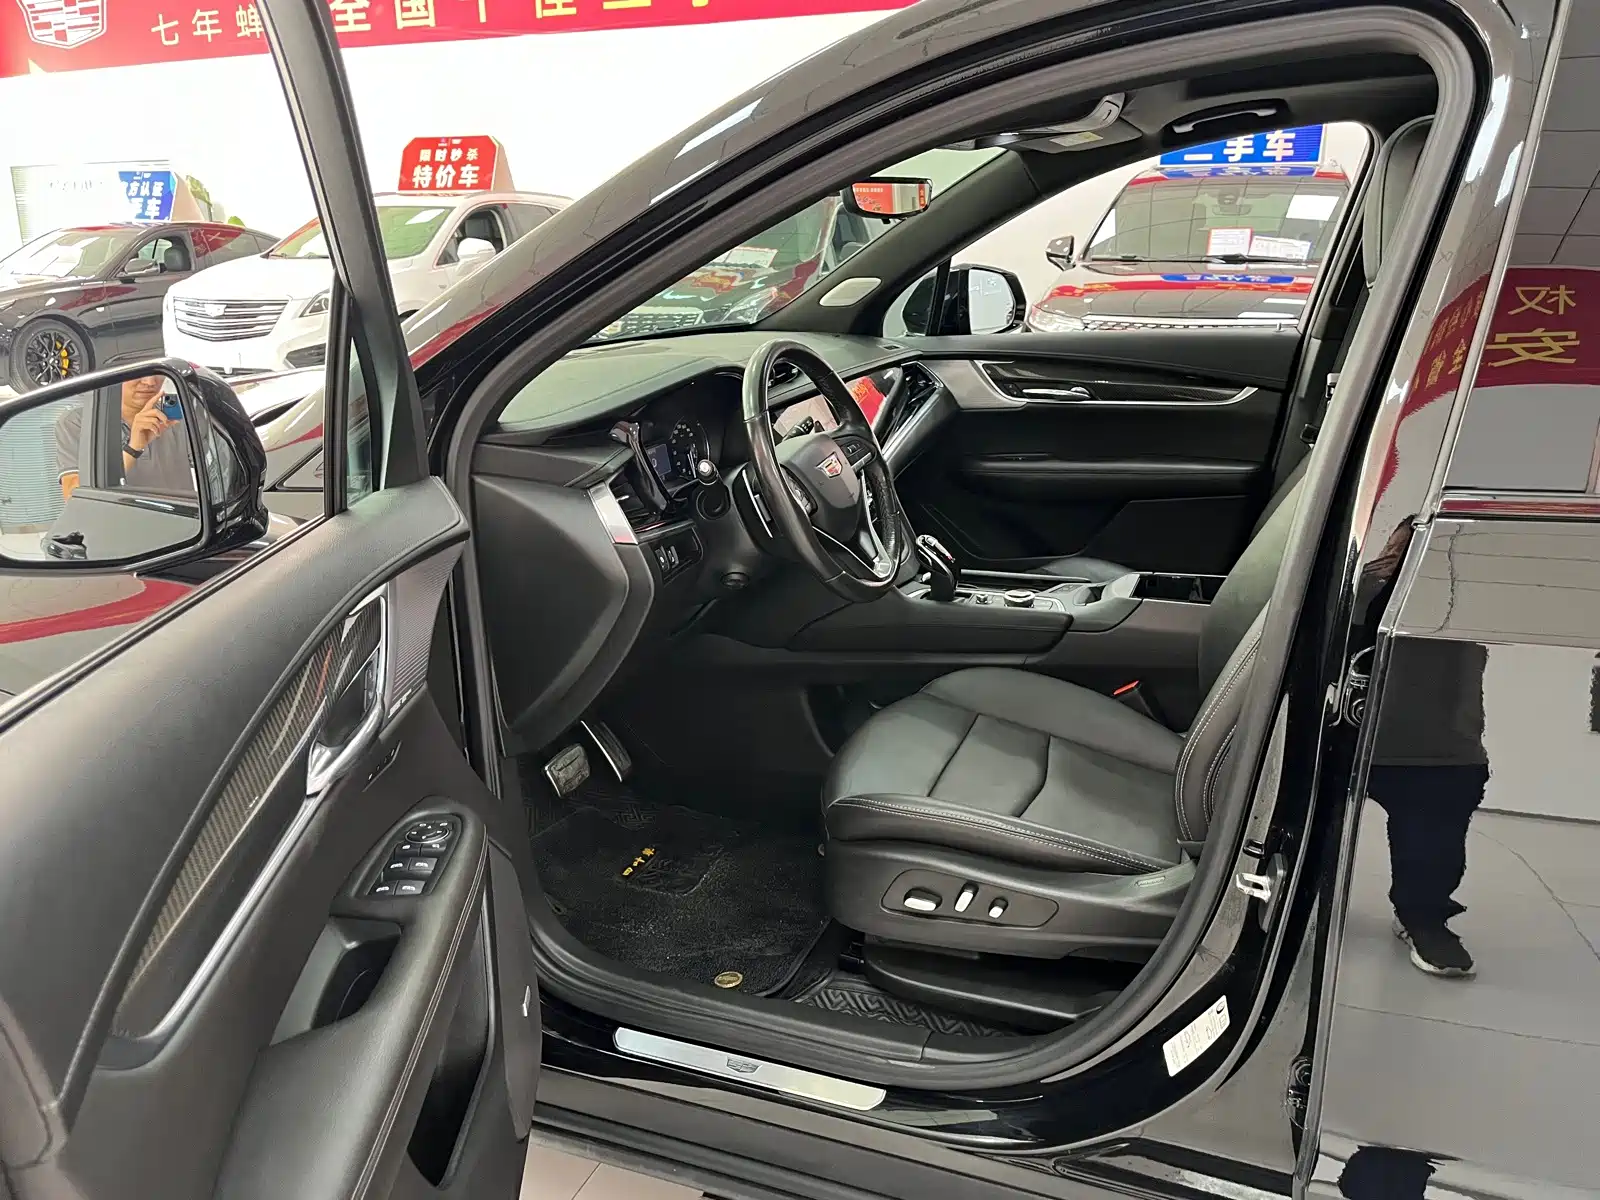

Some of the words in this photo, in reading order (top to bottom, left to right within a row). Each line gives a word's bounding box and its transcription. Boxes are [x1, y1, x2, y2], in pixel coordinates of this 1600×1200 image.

[411, 163, 480, 189] 特价车
[118, 180, 165, 198] 方认证
